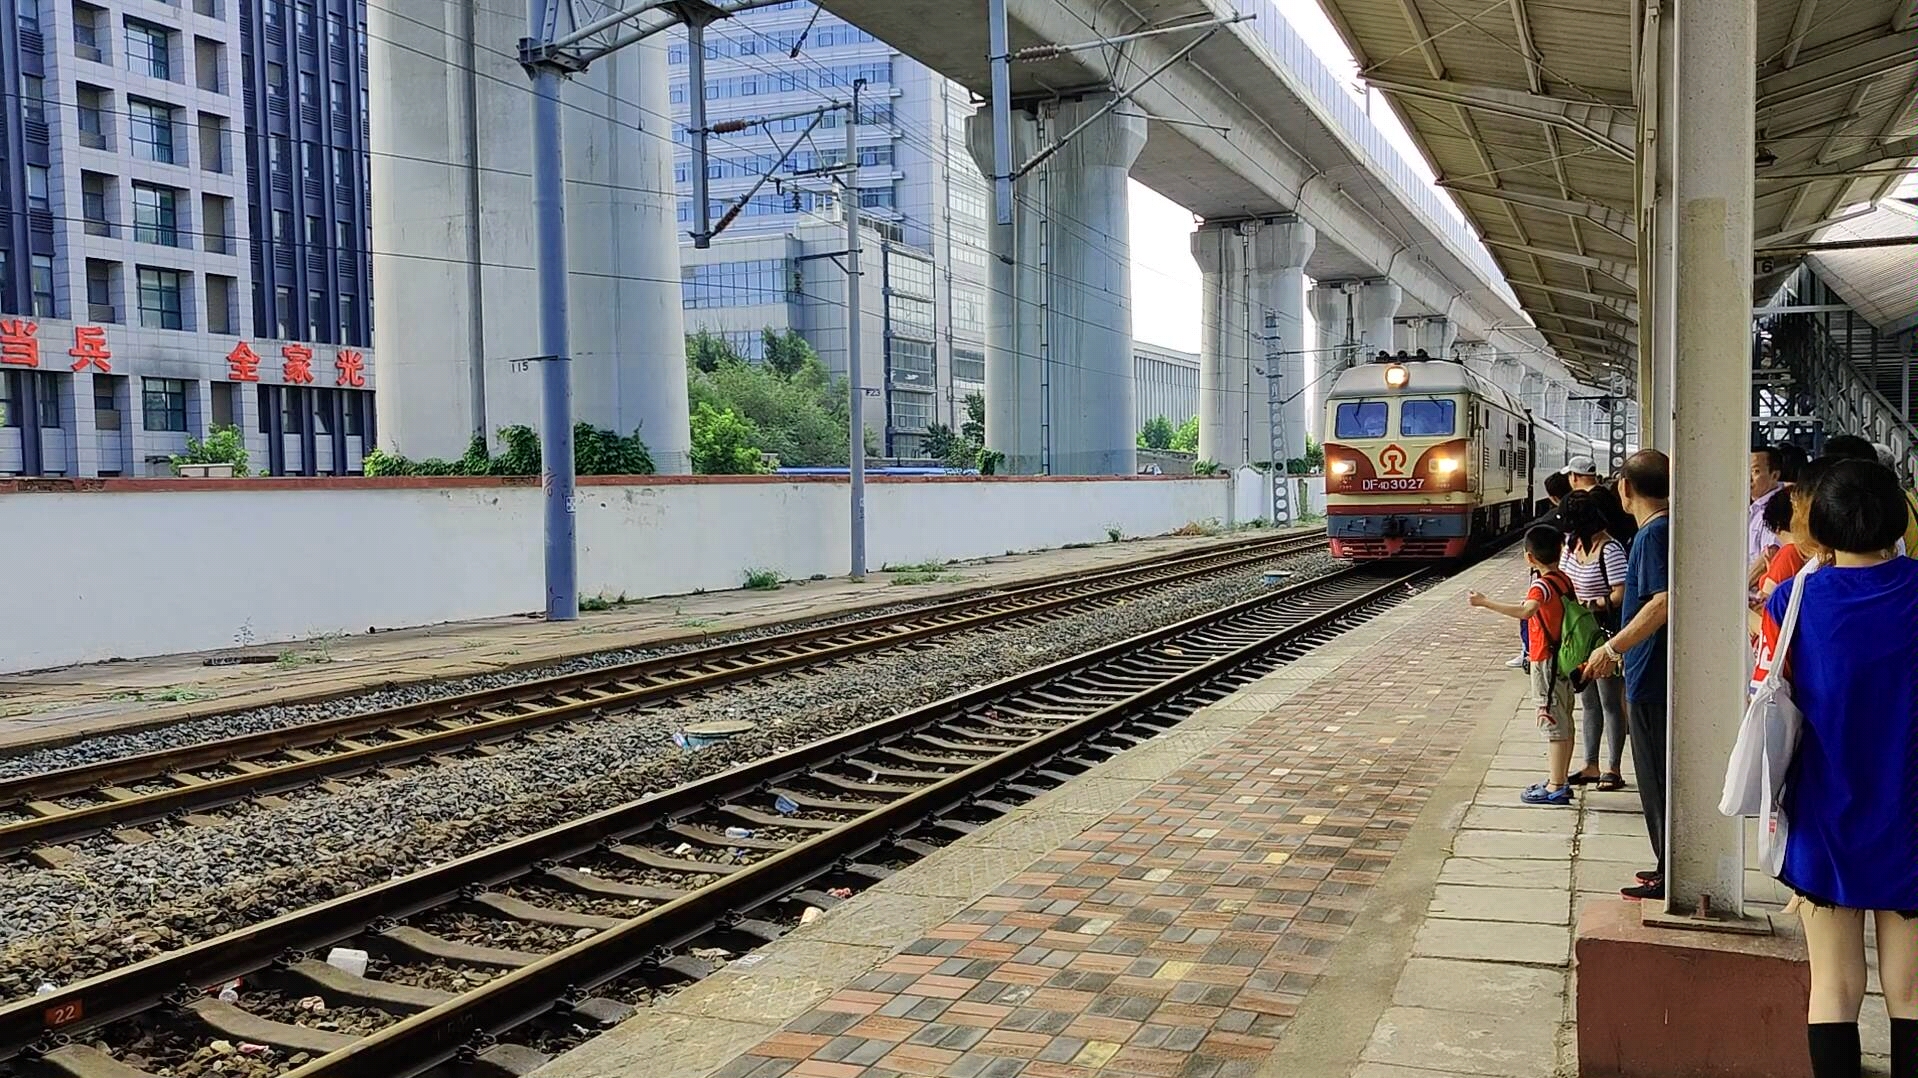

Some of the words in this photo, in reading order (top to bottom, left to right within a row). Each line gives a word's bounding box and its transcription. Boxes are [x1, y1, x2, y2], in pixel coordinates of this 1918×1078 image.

[0, 318, 112, 373] 当兵
[226, 341, 366, 387] 全家光
[511, 361, 529, 373] 115
[54, 1005, 76, 1025] 22
